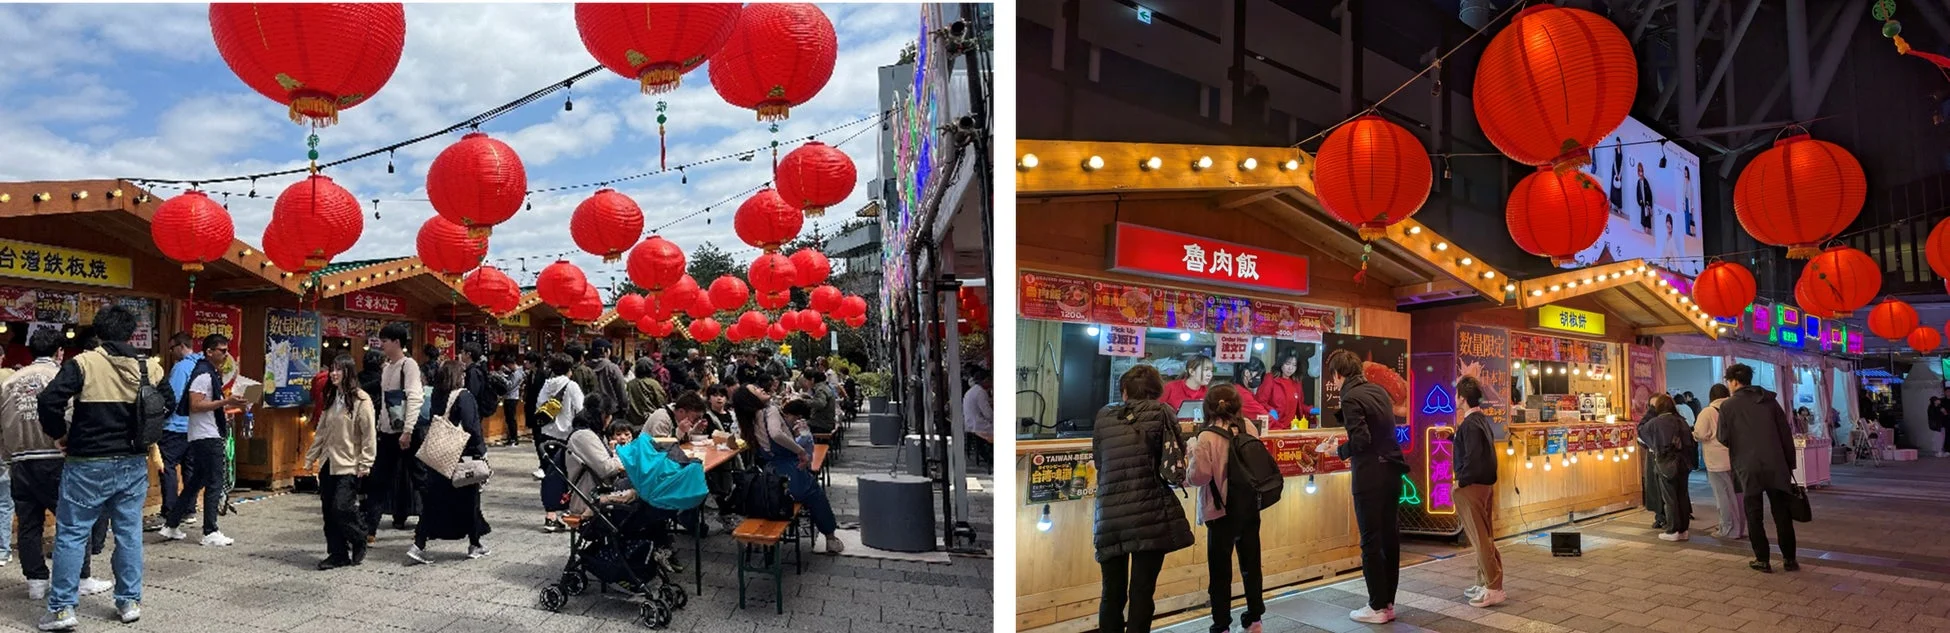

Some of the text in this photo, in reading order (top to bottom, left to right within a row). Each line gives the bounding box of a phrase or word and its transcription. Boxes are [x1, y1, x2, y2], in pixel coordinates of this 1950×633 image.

[1182, 243, 1260, 281] 魯肉飯
[1559, 311, 1587, 329] 胡椒餅
[1126, 327, 1136, 335] Up
[1221, 343, 1247, 353] 注文口
[1460, 332, 1505, 358] 数量限定
[1482, 369, 1505, 387] 日本初
[1397, 427, 1410, 443] 水
[1046, 453, 1094, 463] TAIWAN BEER
[1431, 439, 1455, 508] 大減價
